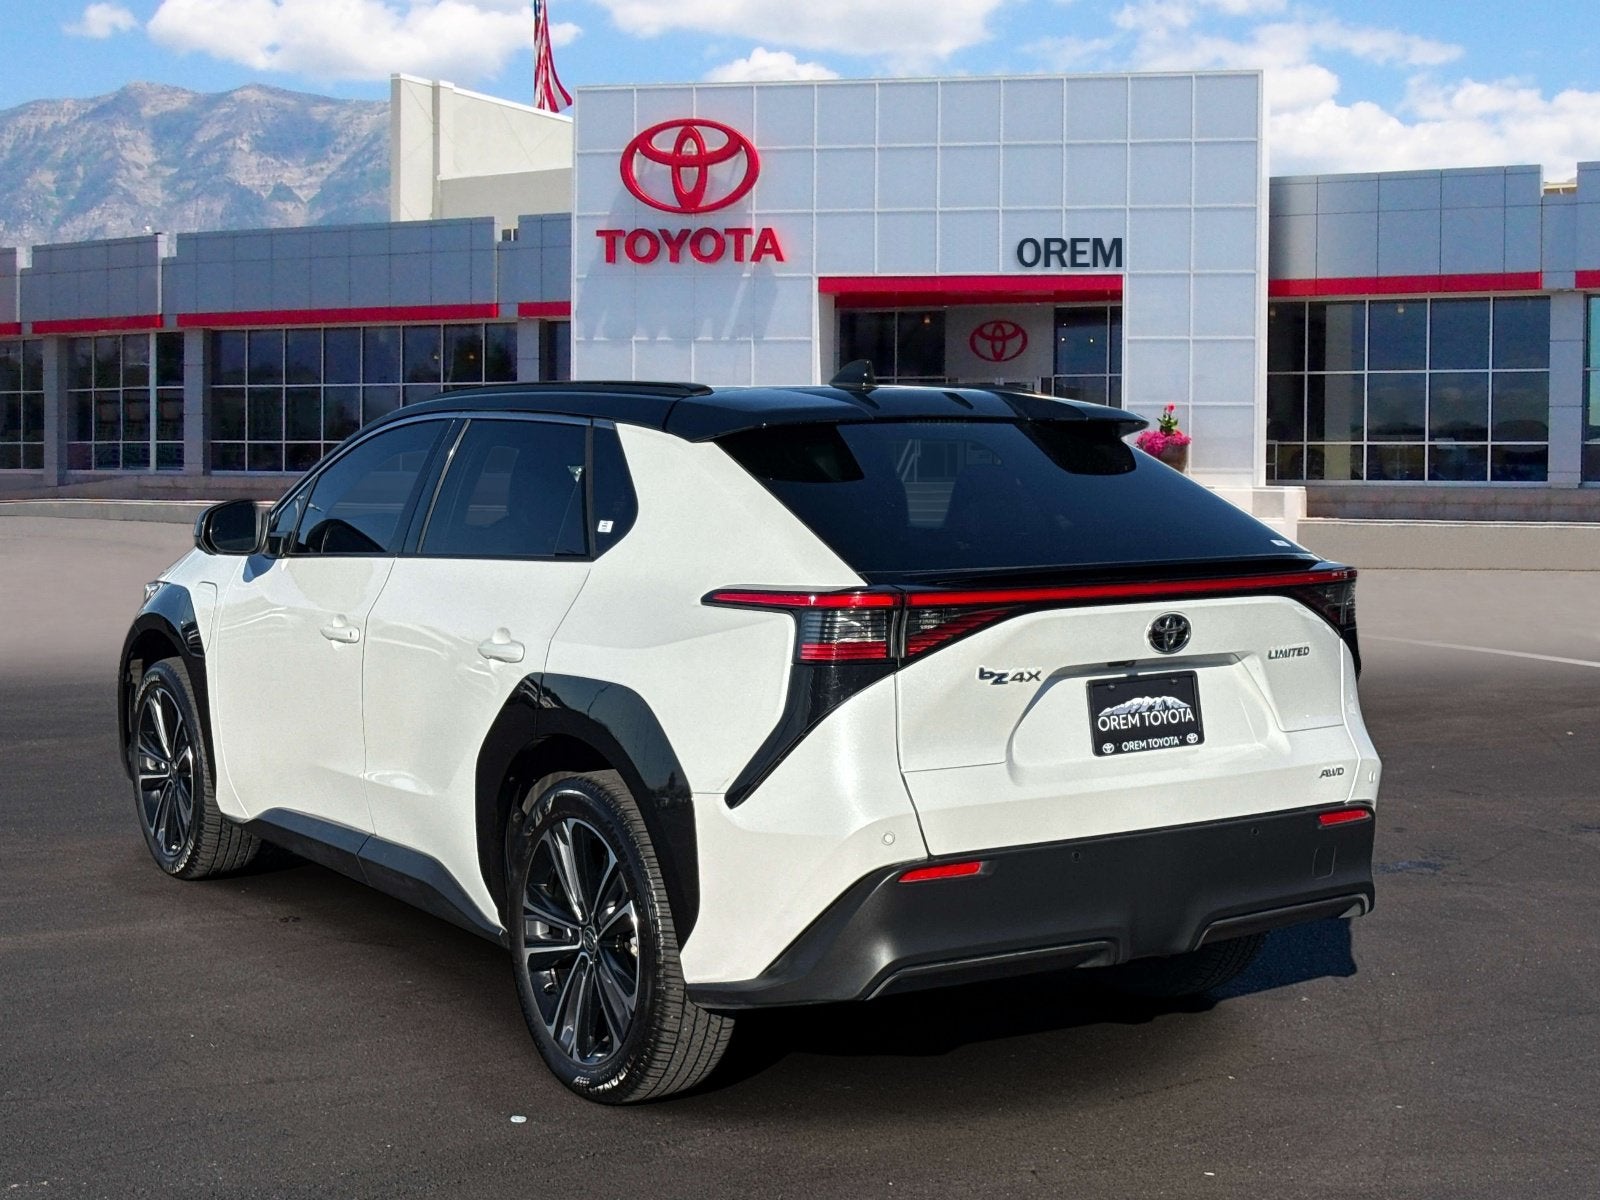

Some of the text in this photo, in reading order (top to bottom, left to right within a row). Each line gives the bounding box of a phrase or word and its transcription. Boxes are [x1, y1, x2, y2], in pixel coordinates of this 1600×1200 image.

[596, 227, 785, 264] TOYOTA
[1017, 237, 1123, 268] OREM
[1268, 646, 1310, 660] LIMITED
[1097, 707, 1195, 732] OREM TOYOTA
[1121, 736, 1180, 752] OREM TOYOTA
[1318, 767, 1345, 779] AWD
